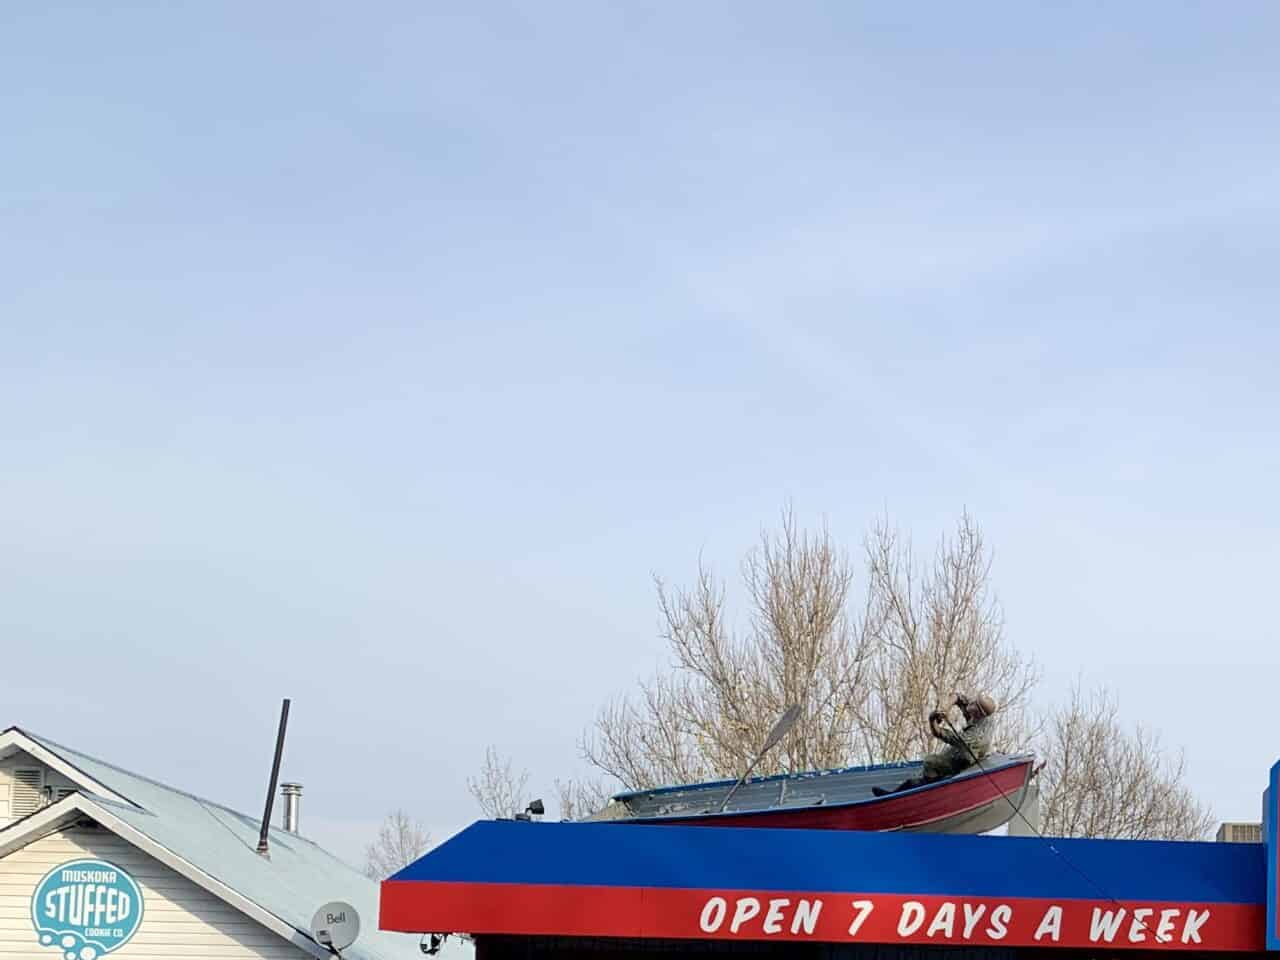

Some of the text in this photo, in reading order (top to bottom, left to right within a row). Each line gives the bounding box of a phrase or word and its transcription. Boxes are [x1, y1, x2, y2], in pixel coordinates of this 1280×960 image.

[61, 869, 118, 884] MUSKOKA
[44, 883, 131, 927] STUFFED
[326, 912, 346, 925] Bell
[699, 896, 1212, 945] OPEN 7 DAYS A WEEK
